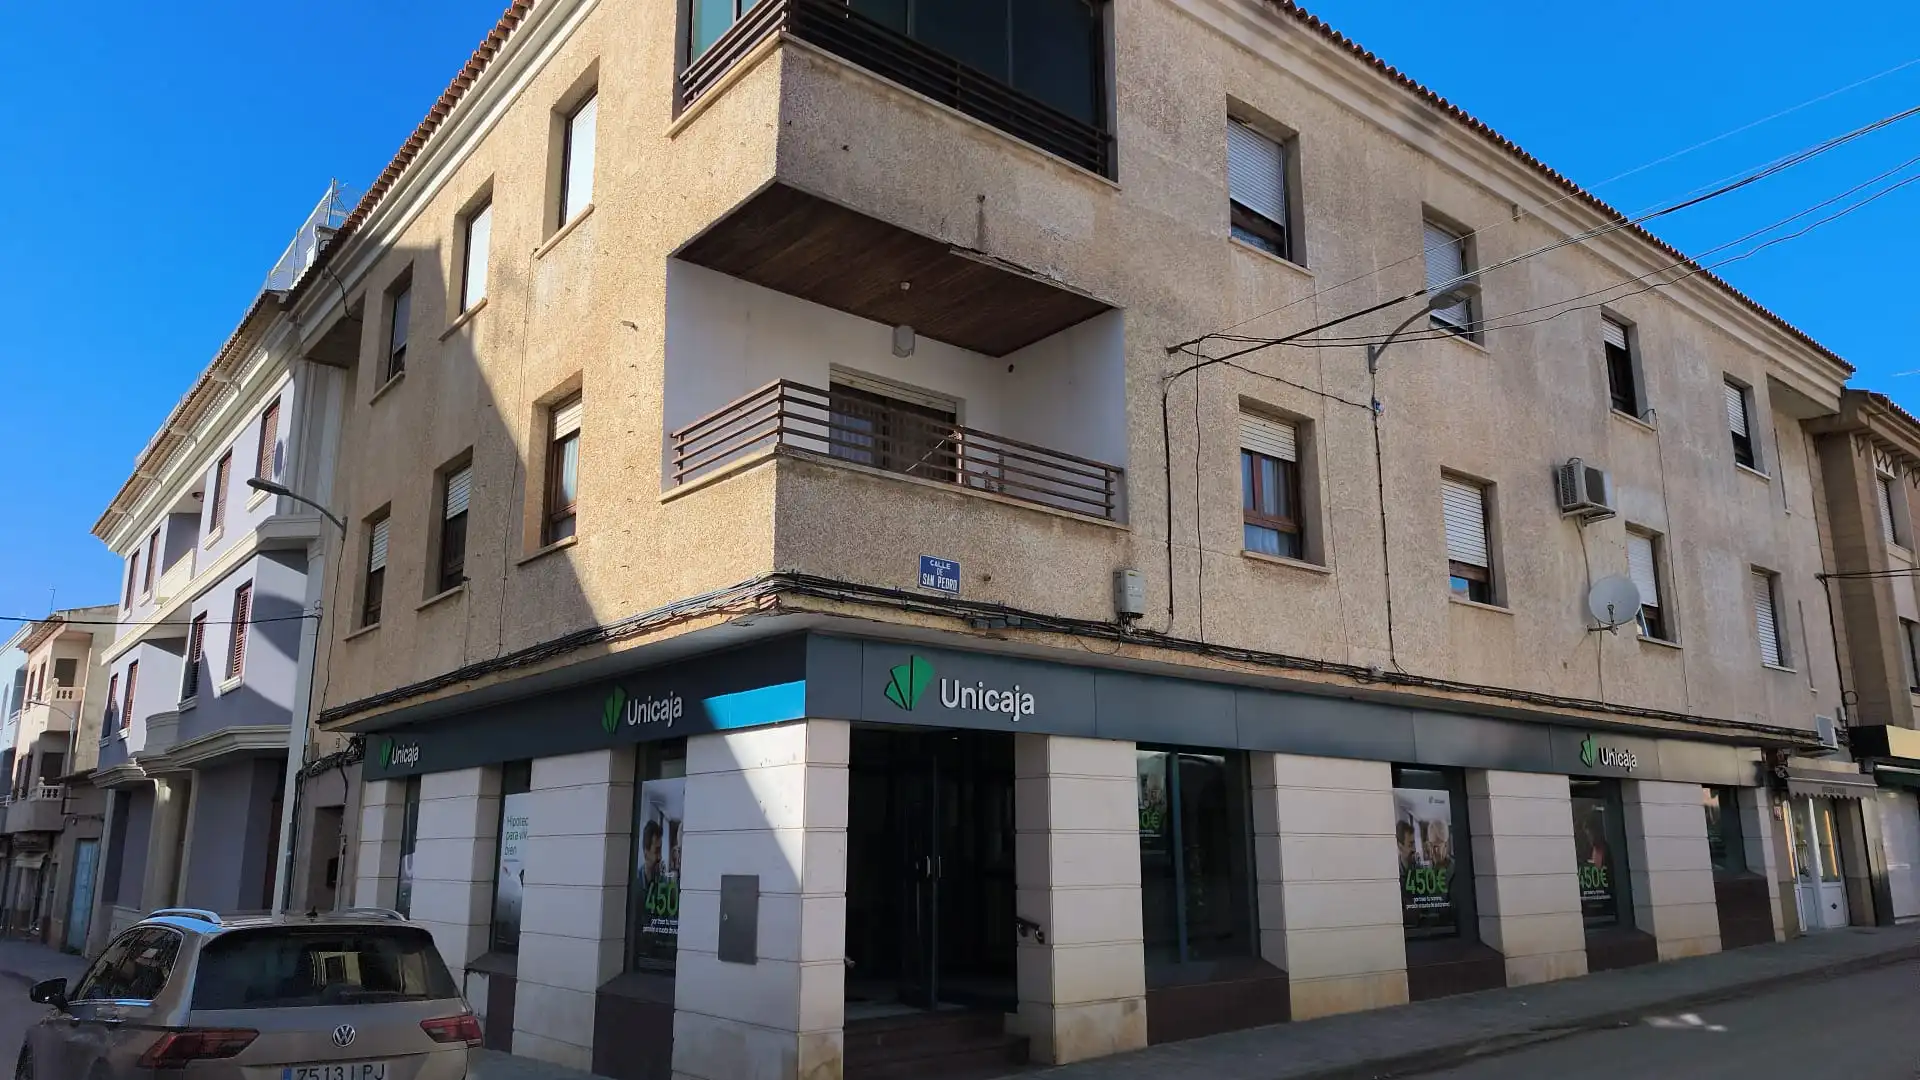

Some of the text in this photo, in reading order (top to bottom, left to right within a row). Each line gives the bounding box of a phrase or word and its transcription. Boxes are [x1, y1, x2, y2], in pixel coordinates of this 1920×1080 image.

[930, 560, 951, 570] CALLE
[936, 568, 944, 576] DE
[922, 573, 958, 591] SAN PEDRO
[627, 690, 683, 728] Unicaja
[941, 678, 1035, 722] Unicaja
[392, 741, 419, 768] Unicaja
[1600, 747, 1637, 773] Unicaja
[1405, 868, 1449, 895] 450€
[645, 880, 679, 916] 450
[297, 1066, 344, 1080] 7513
